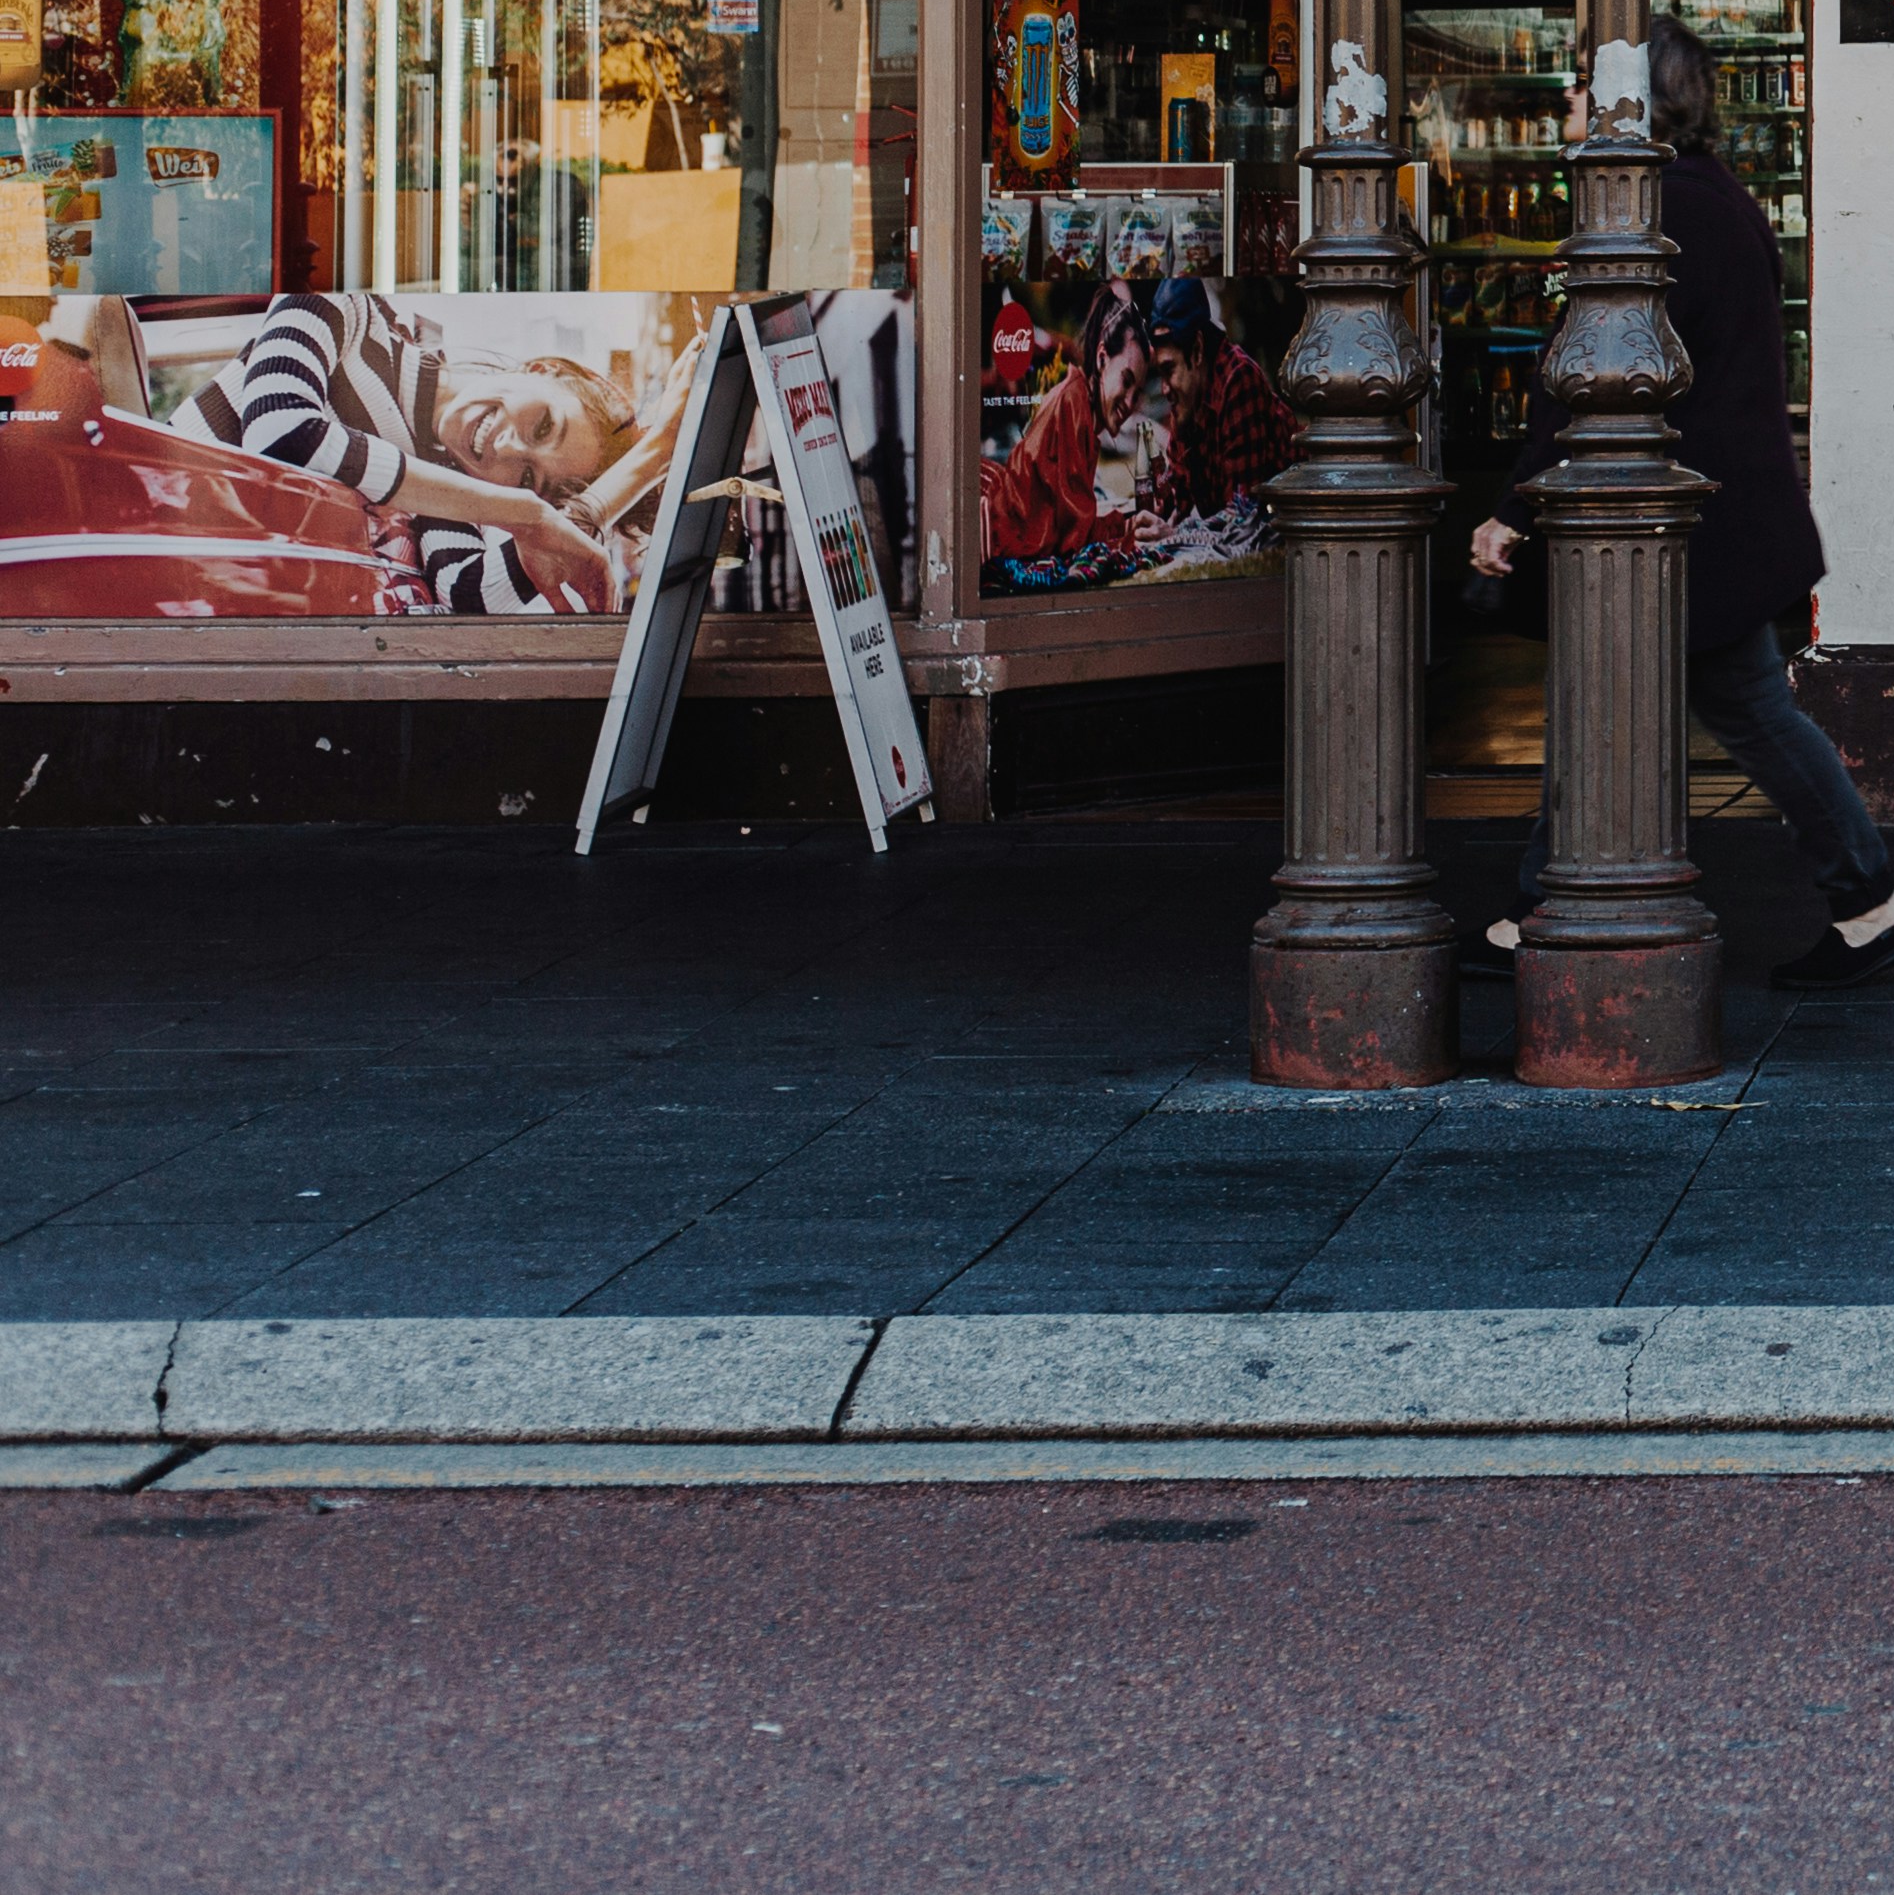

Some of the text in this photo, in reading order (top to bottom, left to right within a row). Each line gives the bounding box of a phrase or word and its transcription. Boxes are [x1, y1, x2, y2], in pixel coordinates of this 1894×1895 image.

[983, 395, 1042, 406] TASTE THE FEELING
[850, 623, 885, 655] AVAILABLE
[864, 654, 884, 679] HERE
